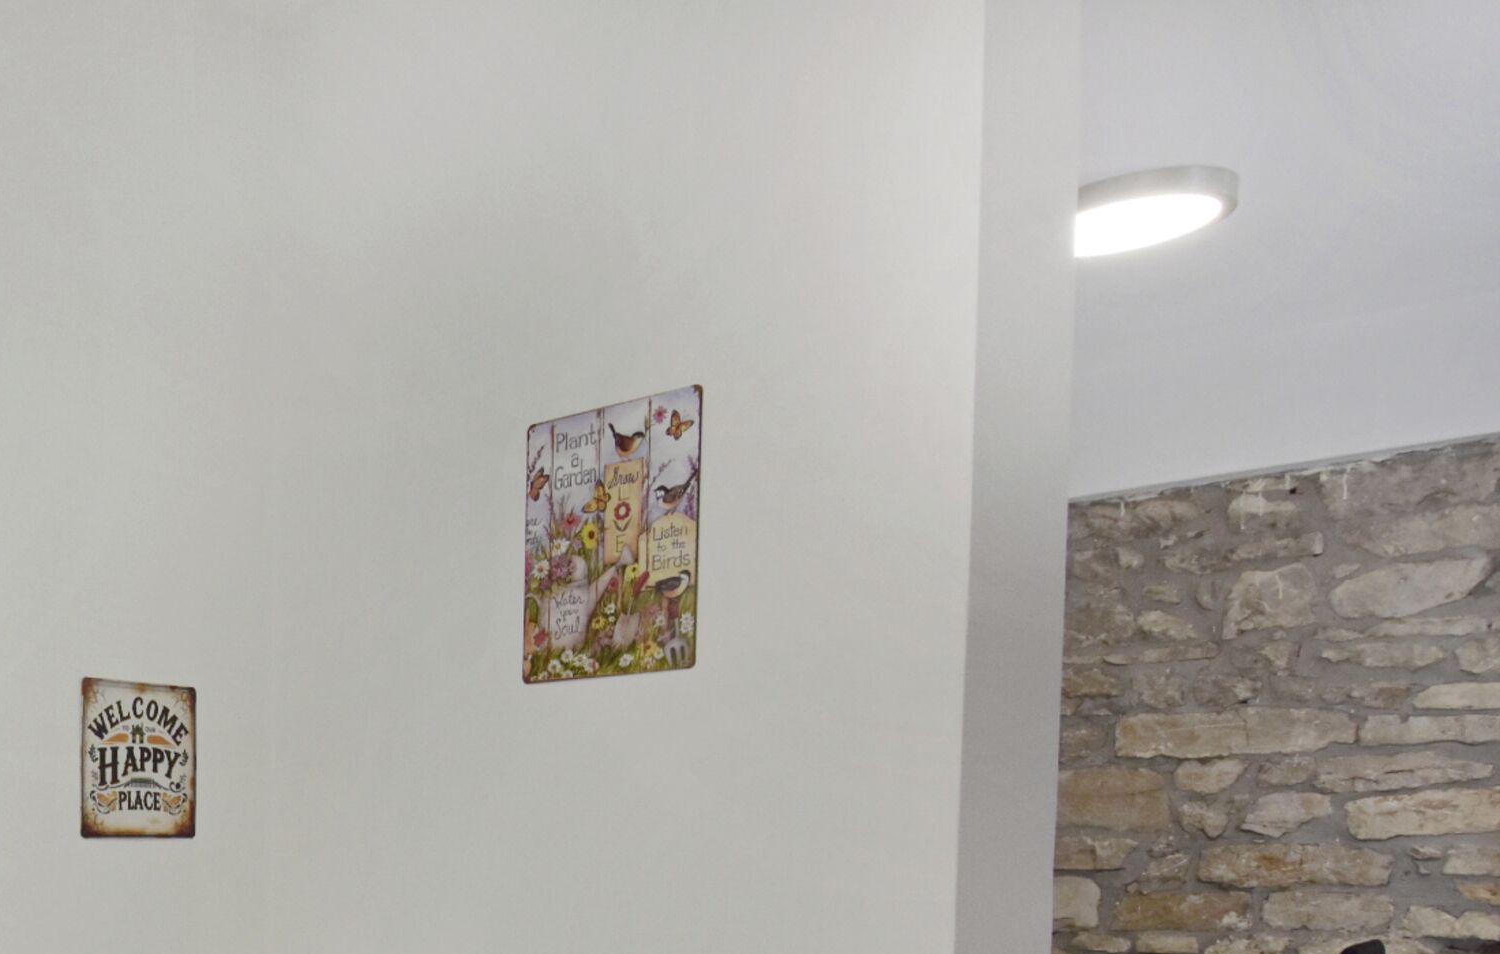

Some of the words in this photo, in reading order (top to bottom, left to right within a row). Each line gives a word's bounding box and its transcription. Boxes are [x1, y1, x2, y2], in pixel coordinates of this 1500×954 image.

[556, 425, 597, 453] Plant
[571, 453, 579, 468] a
[554, 459, 597, 490] Garden
[652, 521, 689, 541] Listen
[657, 541, 667, 552] to
[671, 538, 686, 550] the
[651, 550, 691, 571] Birds
[88, 697, 189, 746] WELCOME
[98, 746, 182, 786] HAPPY
[118, 791, 162, 811] PLACE
